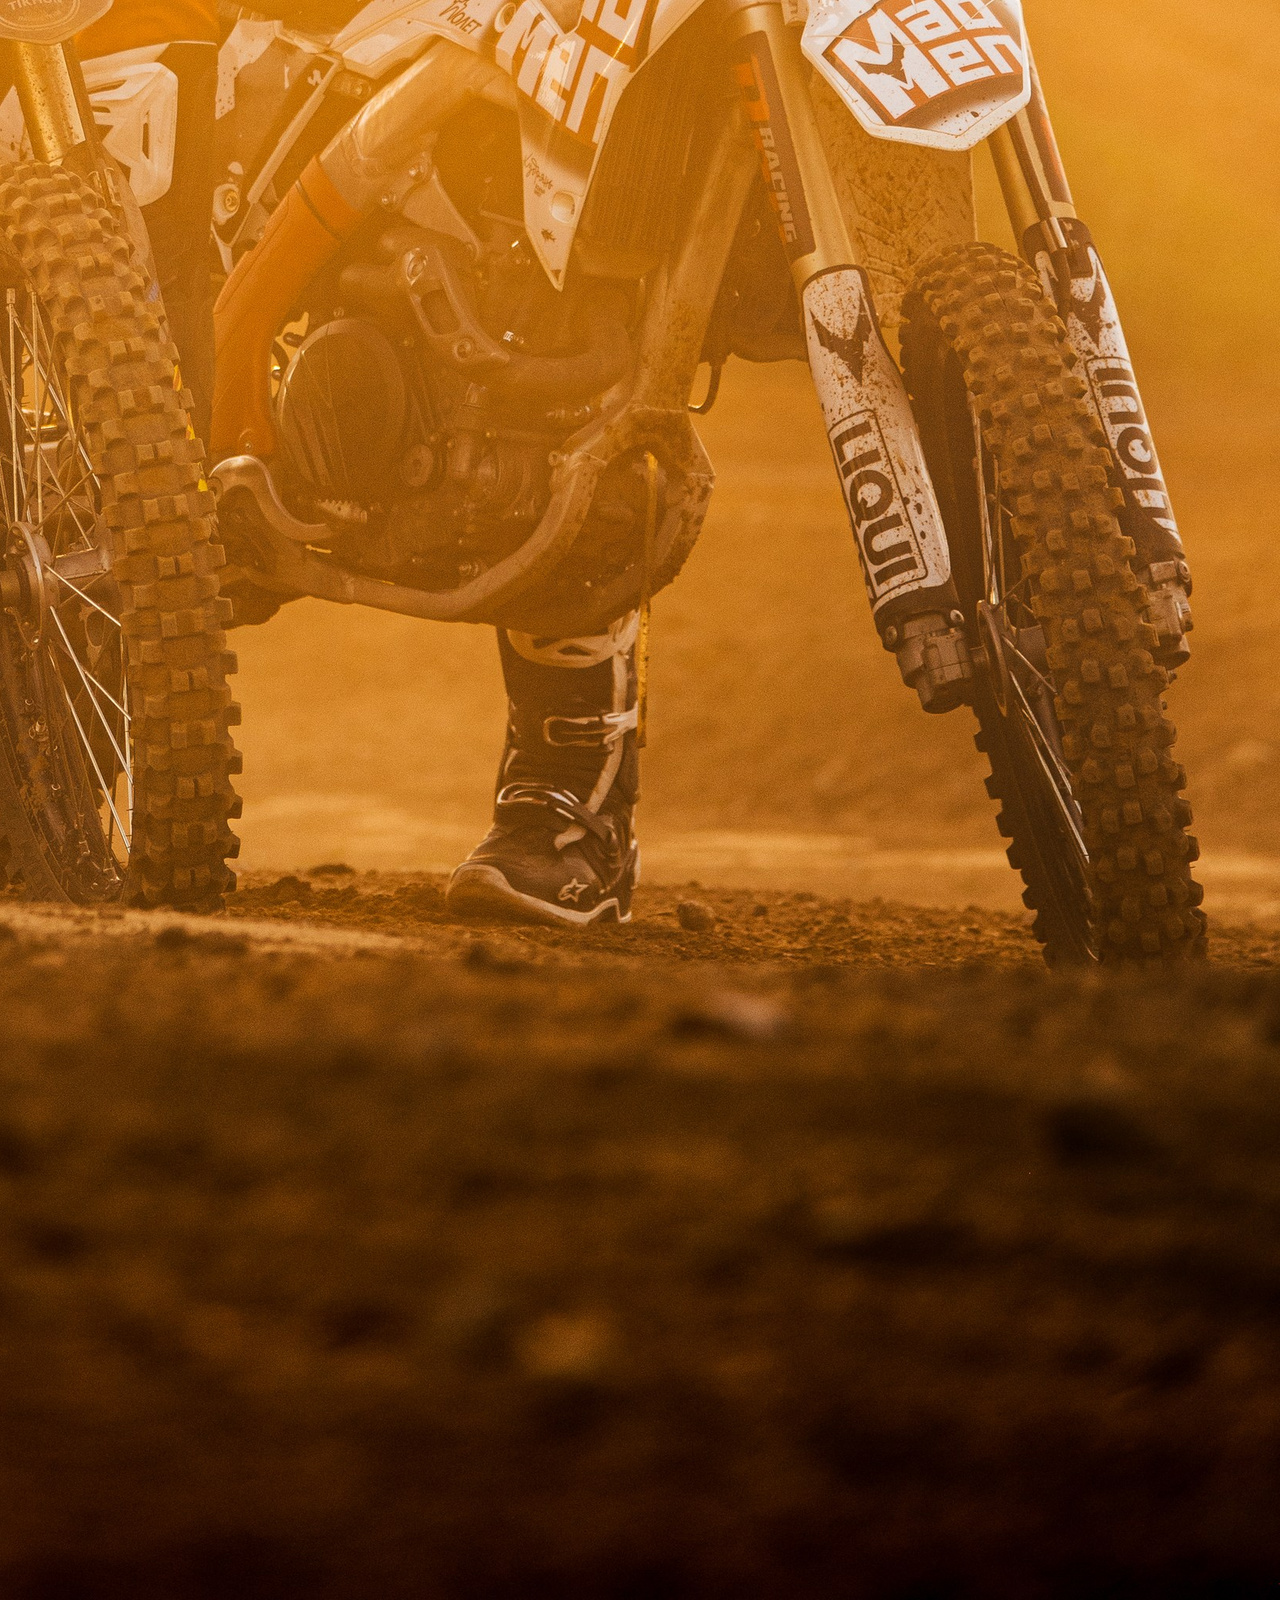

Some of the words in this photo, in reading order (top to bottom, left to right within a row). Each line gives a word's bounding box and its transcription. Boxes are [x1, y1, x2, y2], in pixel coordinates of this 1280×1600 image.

[854, 33, 1023, 120] Men
[758, 127, 798, 244] RACING
[832, 420, 919, 586] LIQUI
